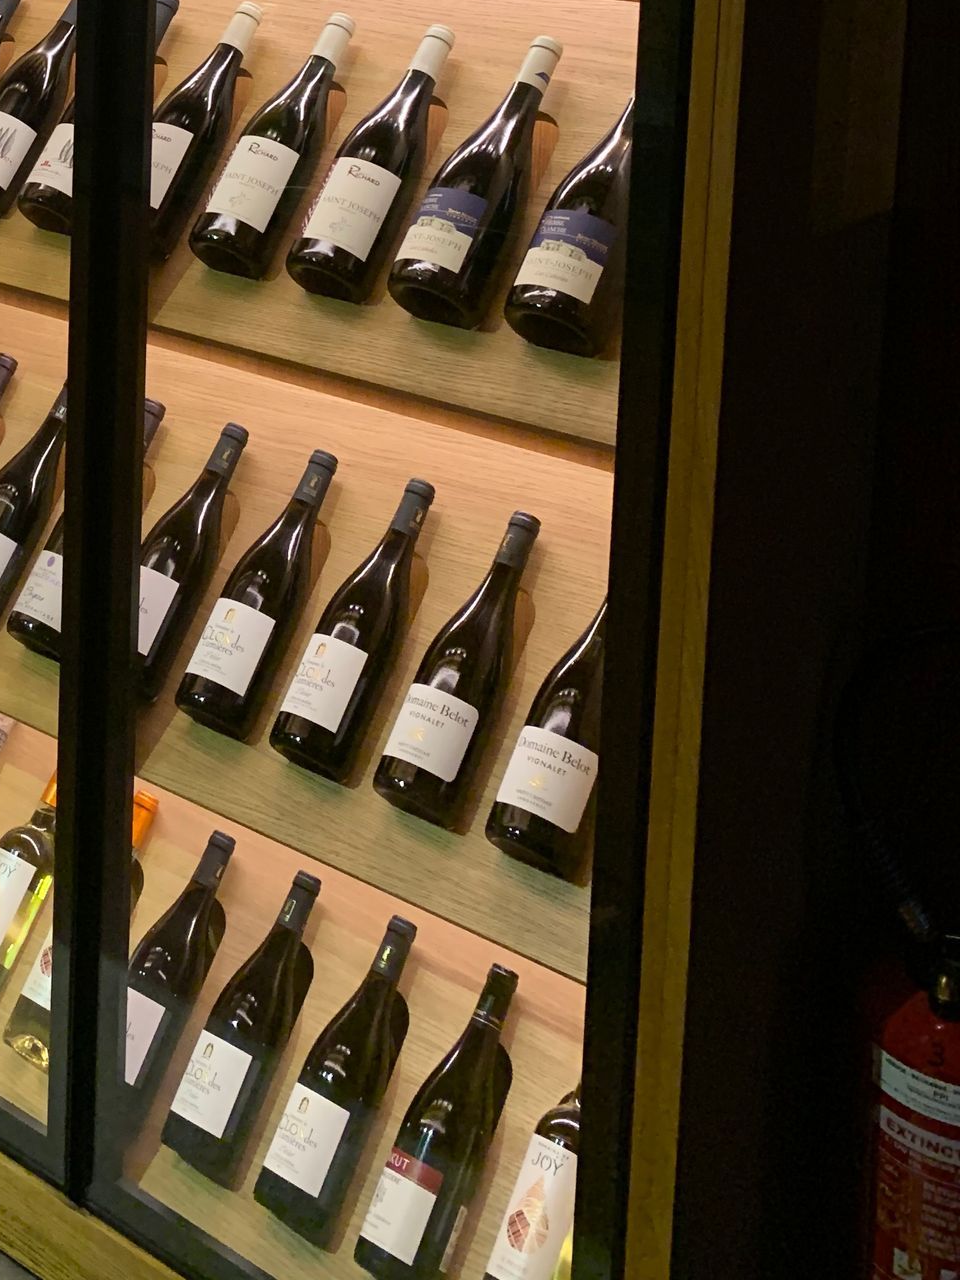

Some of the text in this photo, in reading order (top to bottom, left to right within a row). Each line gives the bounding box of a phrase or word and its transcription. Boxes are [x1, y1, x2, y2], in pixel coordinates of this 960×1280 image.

[440, 704, 470, 728] Belot
[527, 755, 567, 777] VIGNALET
[561, 750, 592, 776] Belot
